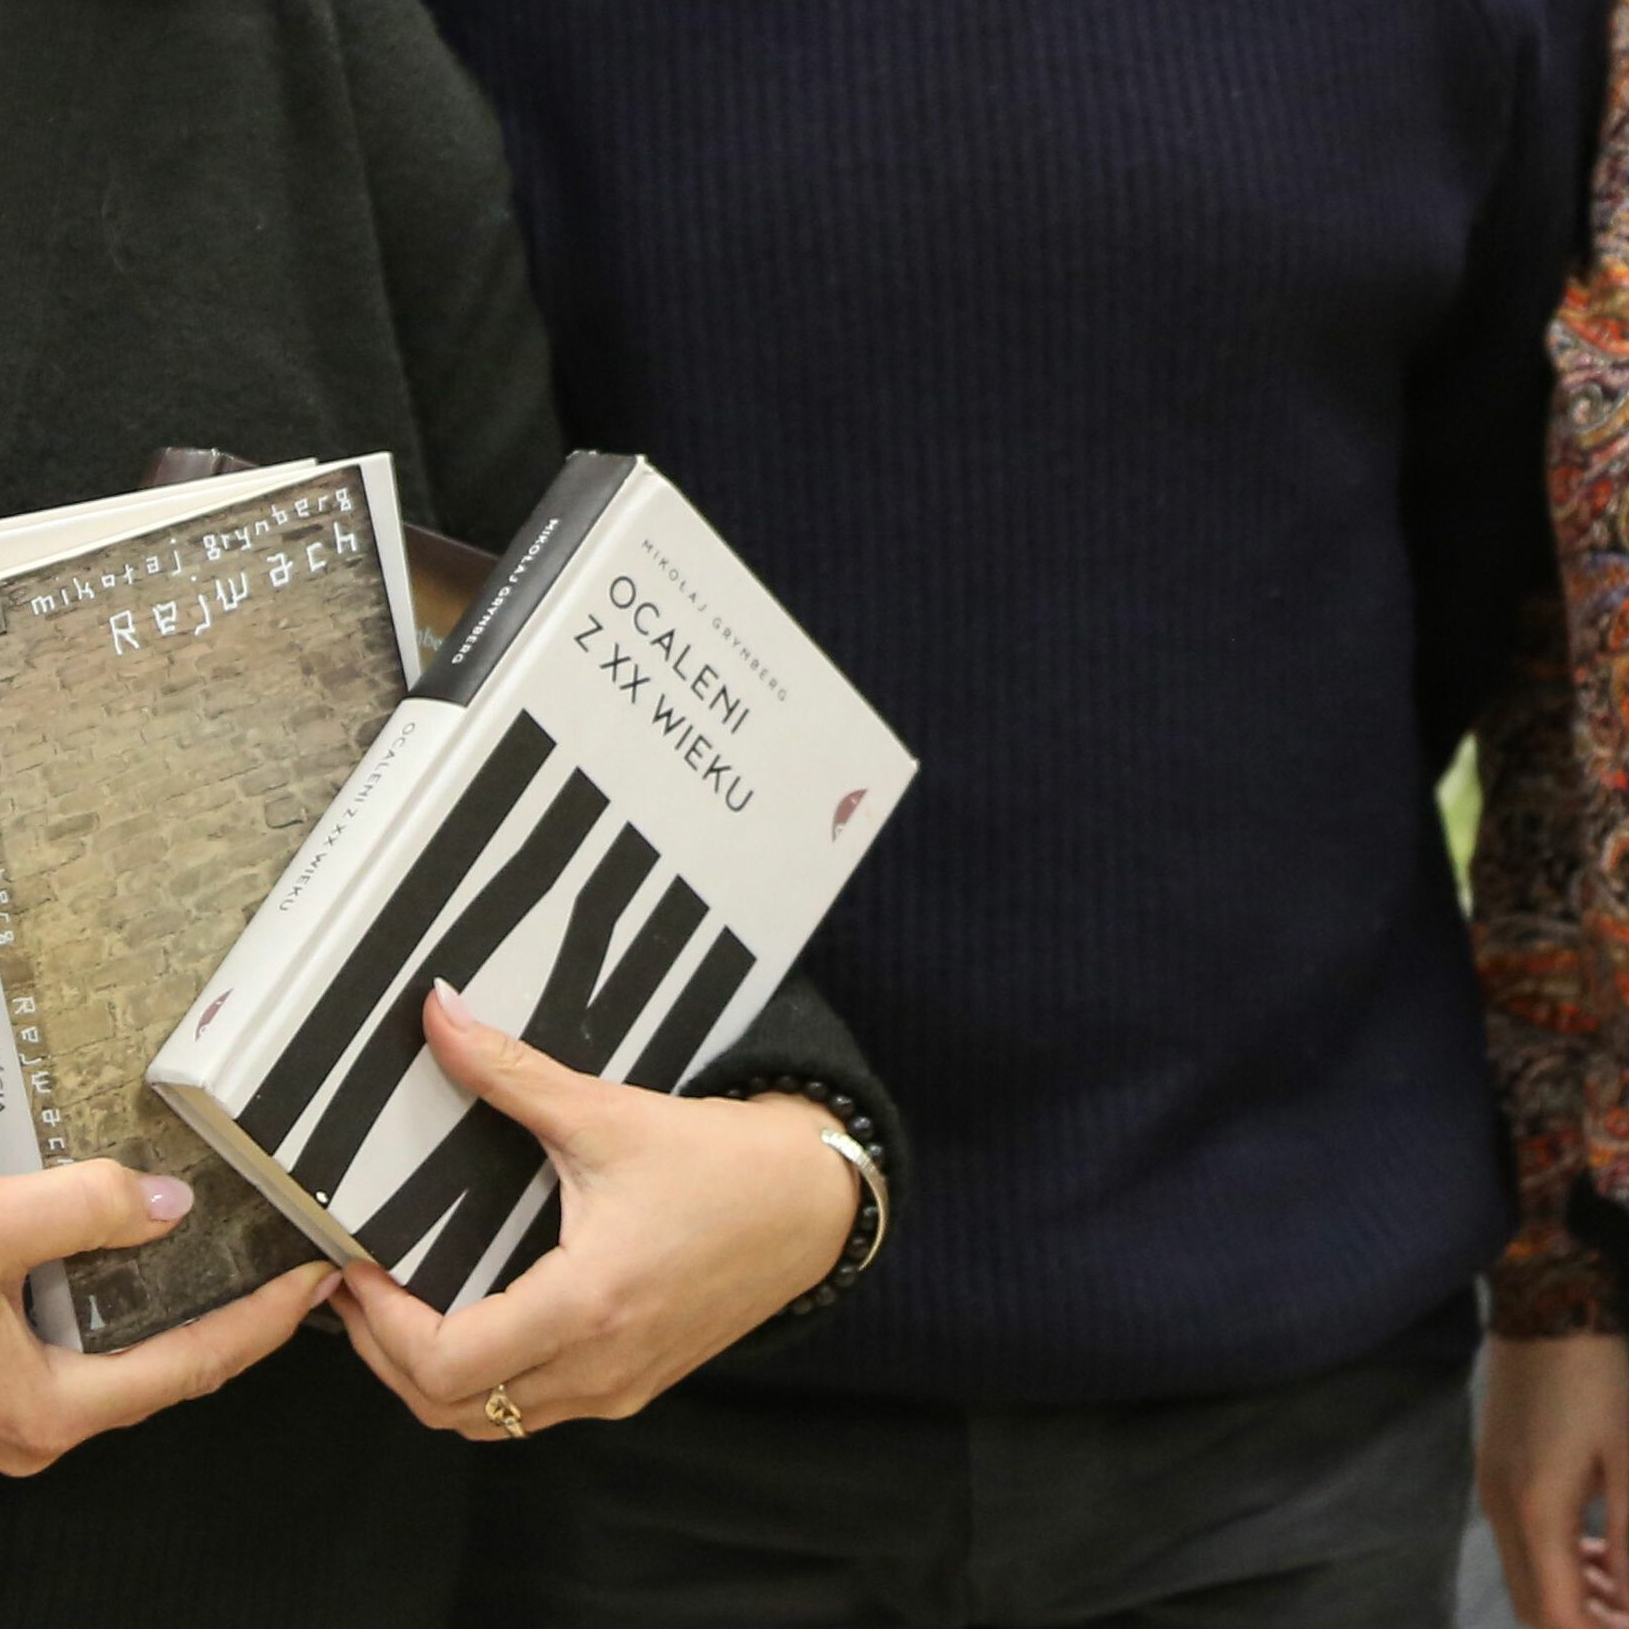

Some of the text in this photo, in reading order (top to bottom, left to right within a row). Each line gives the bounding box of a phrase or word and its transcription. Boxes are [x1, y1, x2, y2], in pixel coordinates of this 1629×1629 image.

[30, 487, 353, 615] mikołaj grynberg
[109, 522, 358, 656] Rejwach
[451, 518, 560, 665] MIKOŁAJ GRYNBERG
[642, 538, 788, 702] MIKOŁAJ GRYNBERG
[573, 613, 754, 813] Z XX WIEKU
[609, 575, 750, 735] OCALENI
[279, 722, 417, 912] OCALENI Z XX WIEKU
